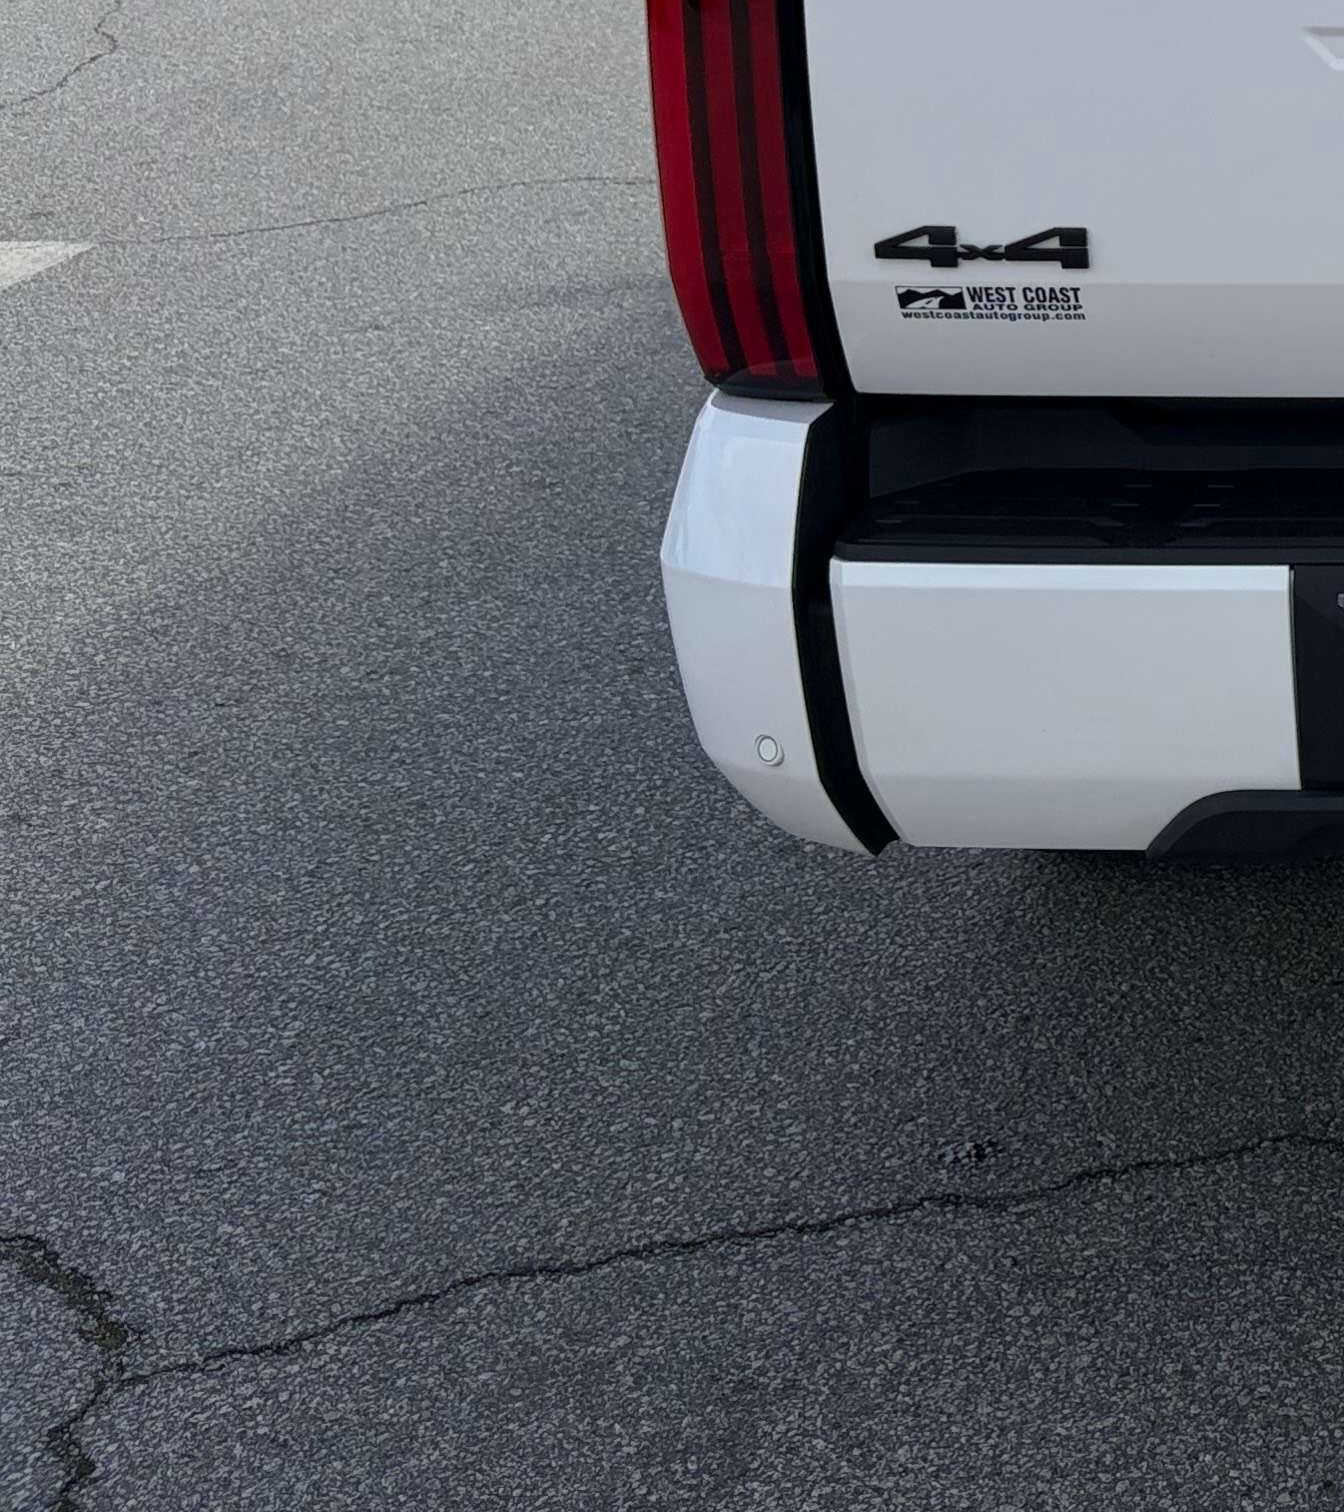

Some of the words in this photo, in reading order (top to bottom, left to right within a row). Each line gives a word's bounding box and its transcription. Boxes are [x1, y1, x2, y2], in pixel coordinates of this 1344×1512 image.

[966, 286, 1016, 304] WEST
[1022, 286, 1081, 304] COAST
[972, 303, 1019, 312] AUTO
[1023, 303, 1083, 312] GROUP
[901, 310, 1086, 322] westcoastautogroup.com
